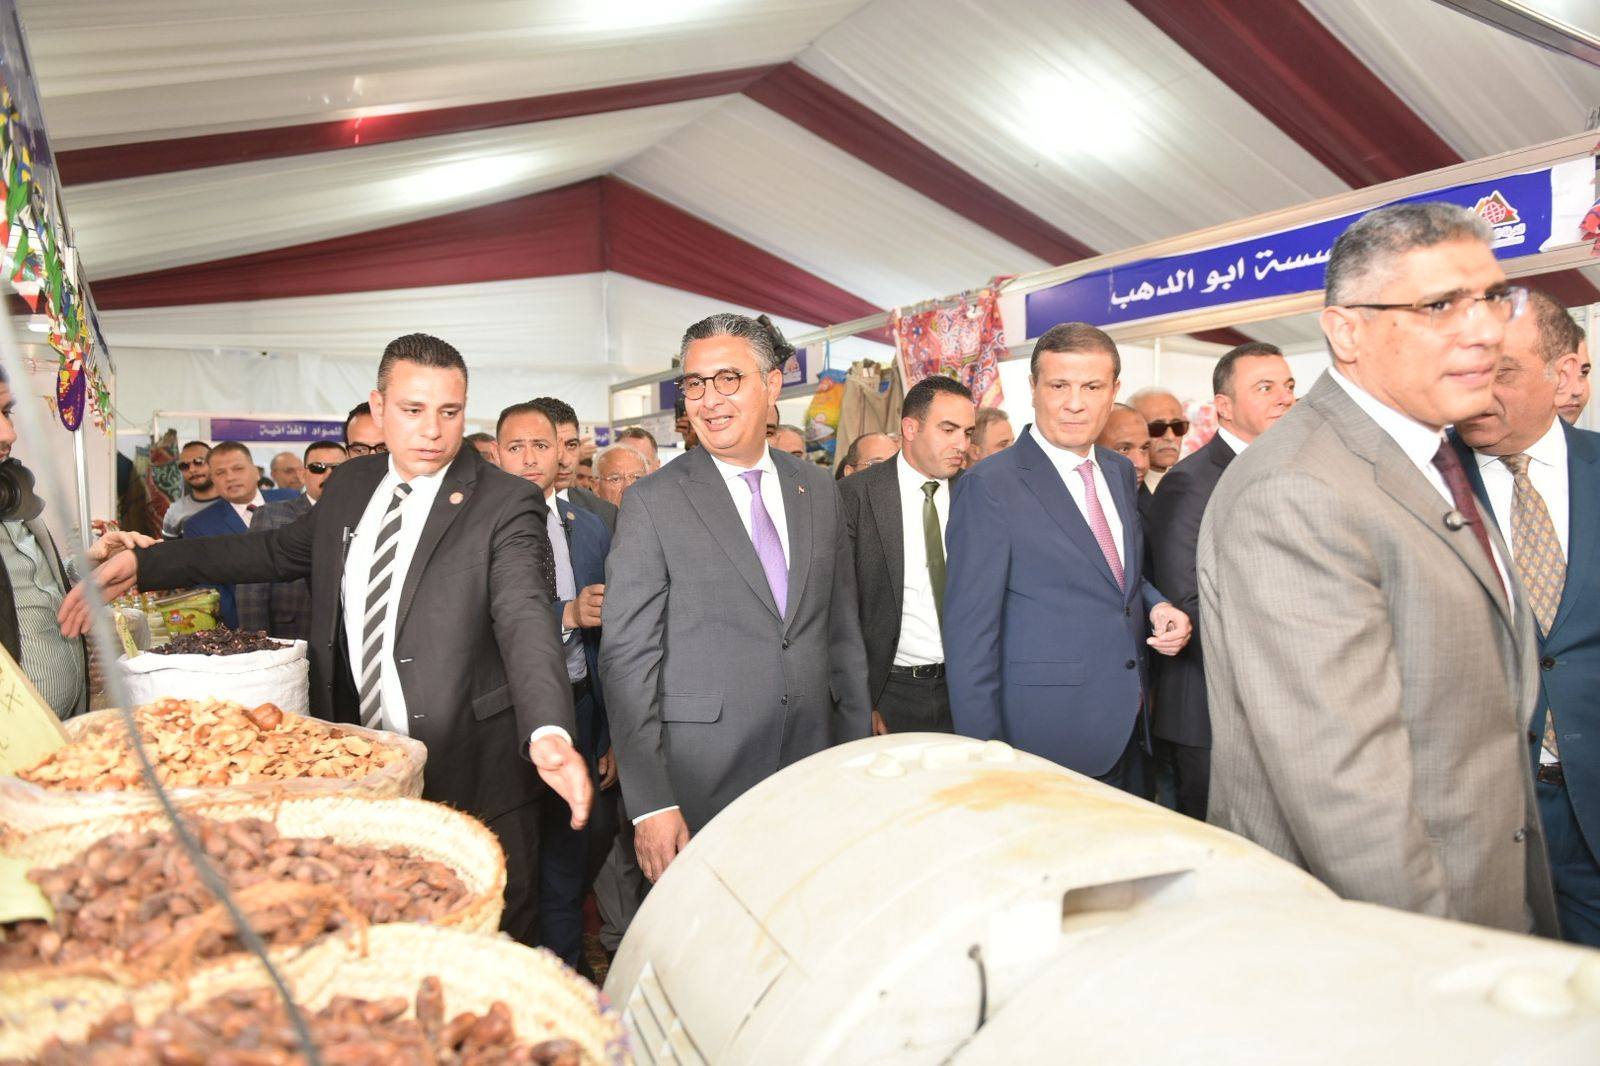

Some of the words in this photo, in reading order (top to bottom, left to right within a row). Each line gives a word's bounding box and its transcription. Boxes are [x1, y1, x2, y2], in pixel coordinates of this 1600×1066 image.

[1200, 257, 1244, 293] ابو
[1254, 248, 1331, 281] سسة
[1111, 269, 1195, 309] الدهب
